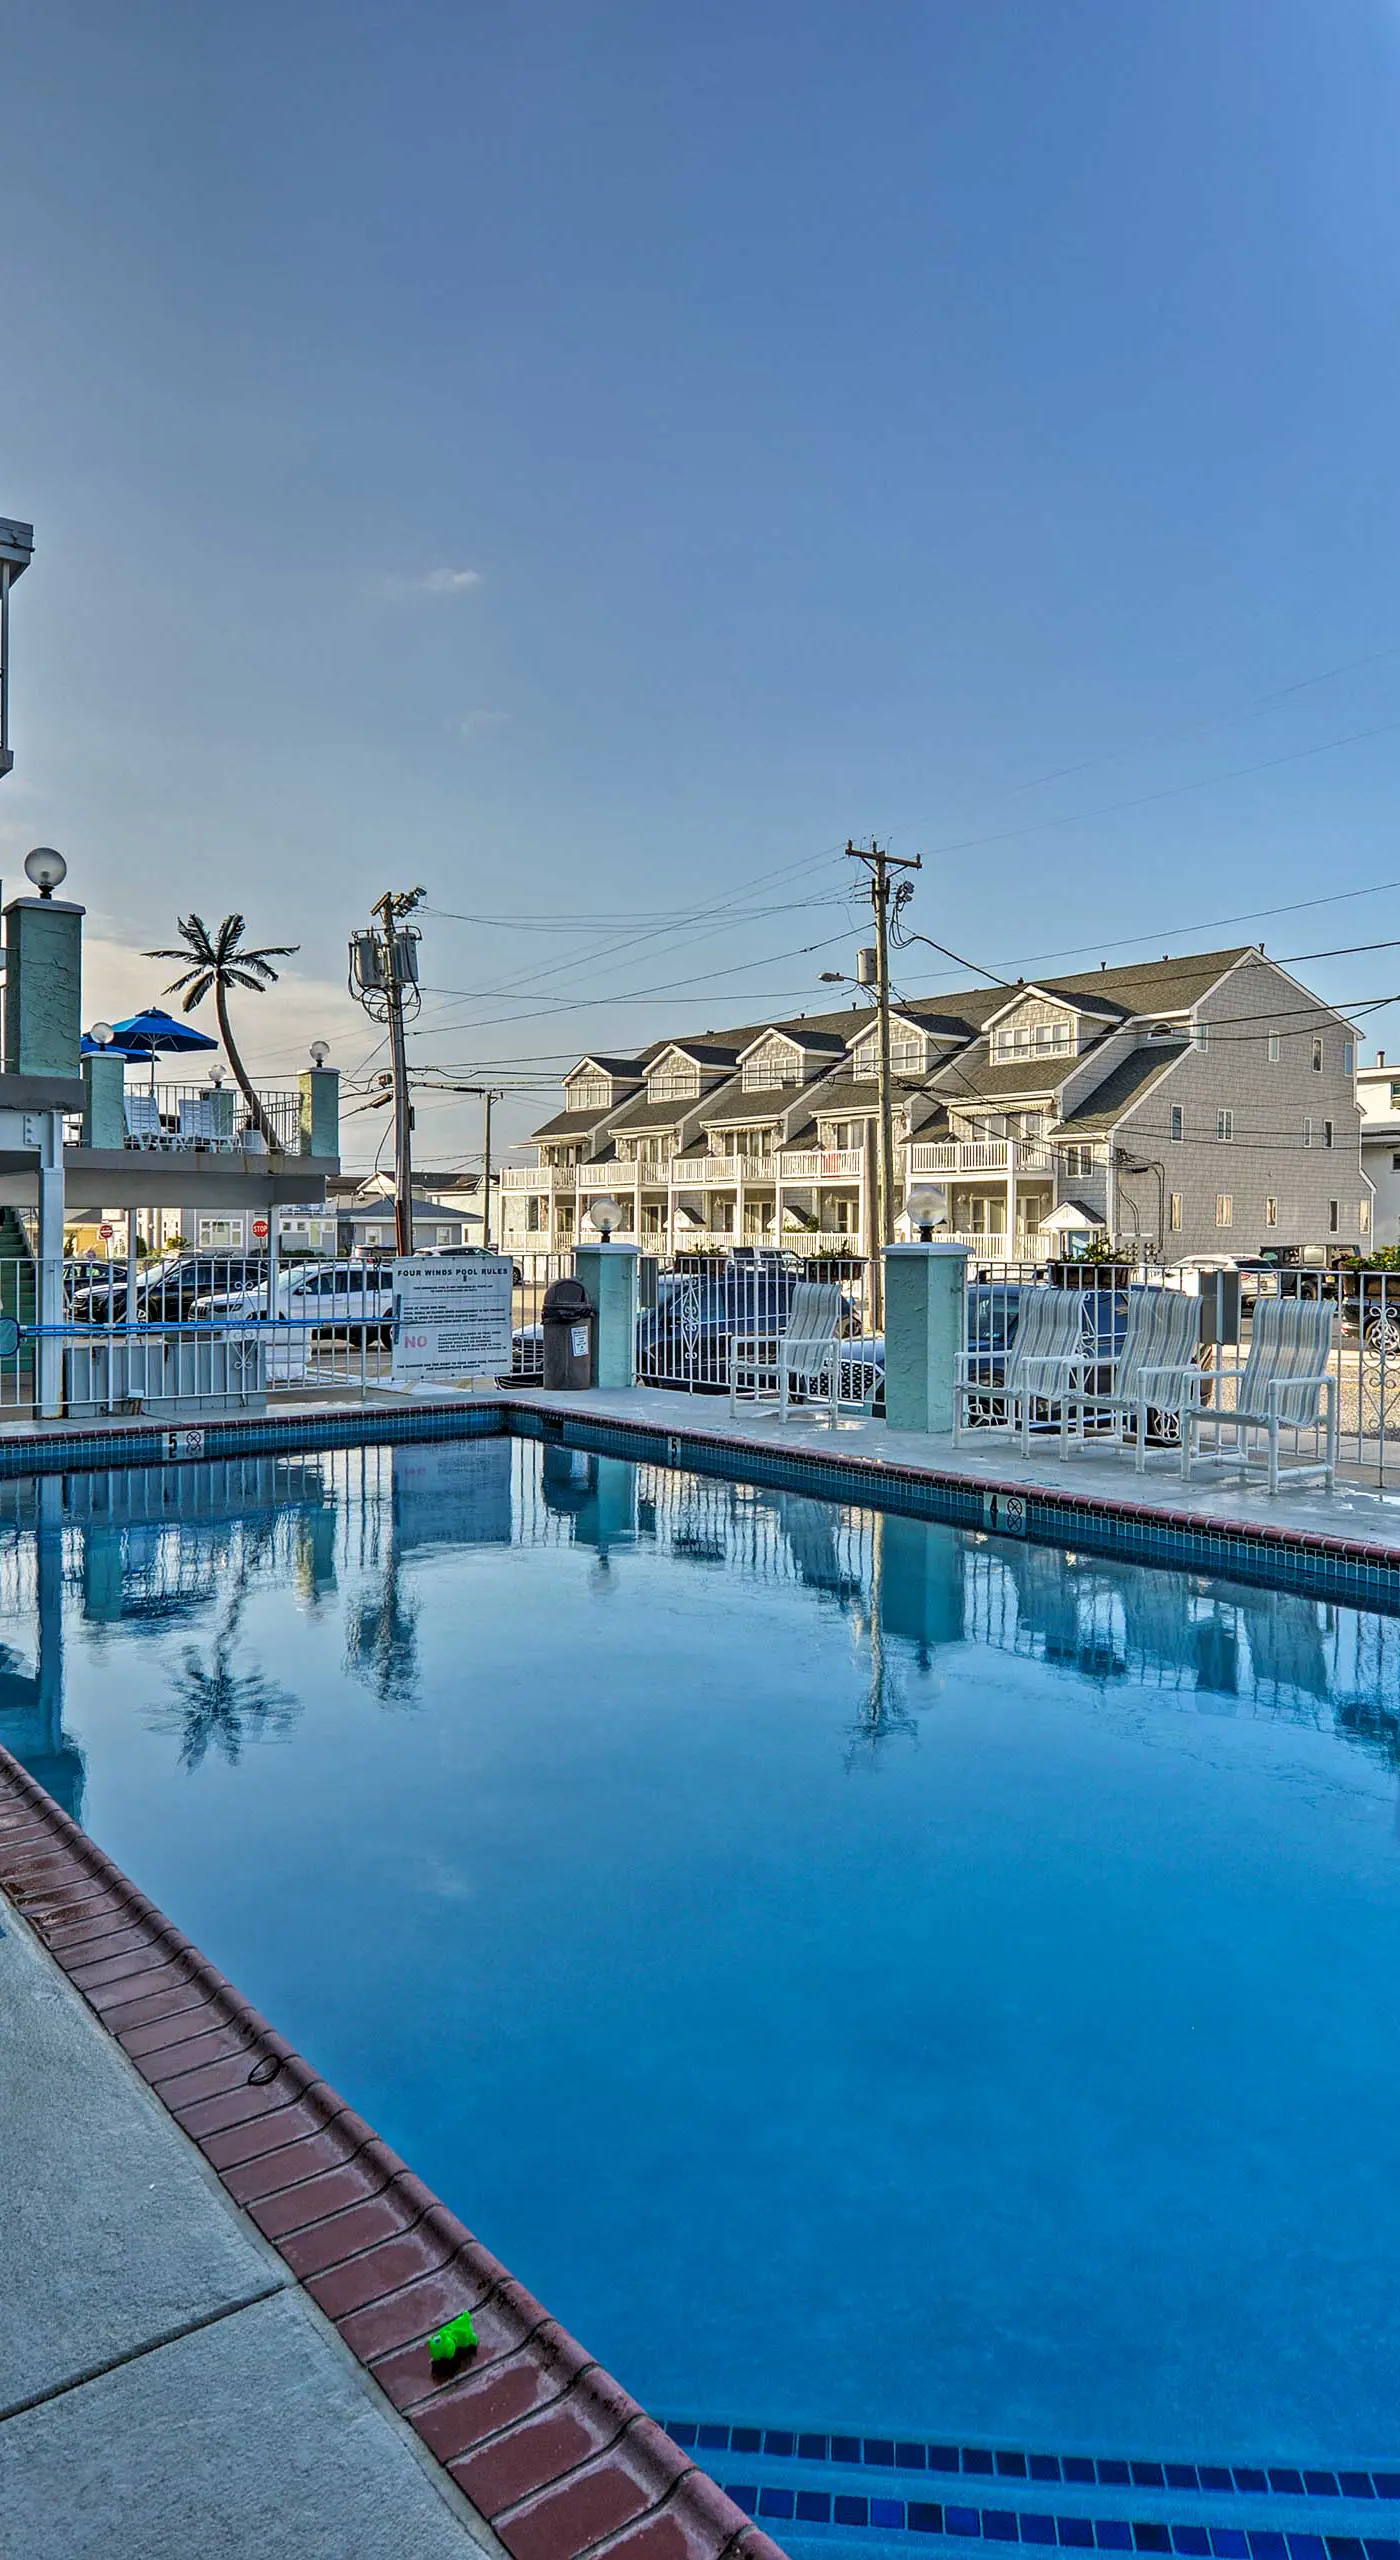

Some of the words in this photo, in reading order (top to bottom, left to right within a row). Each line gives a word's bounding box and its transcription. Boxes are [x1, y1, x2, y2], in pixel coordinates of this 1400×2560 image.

[397, 1269, 421, 1277] FOUR
[455, 1268, 478, 1276] POOL
[404, 1335, 428, 1348] NO
[169, 1433, 177, 1449] 5
